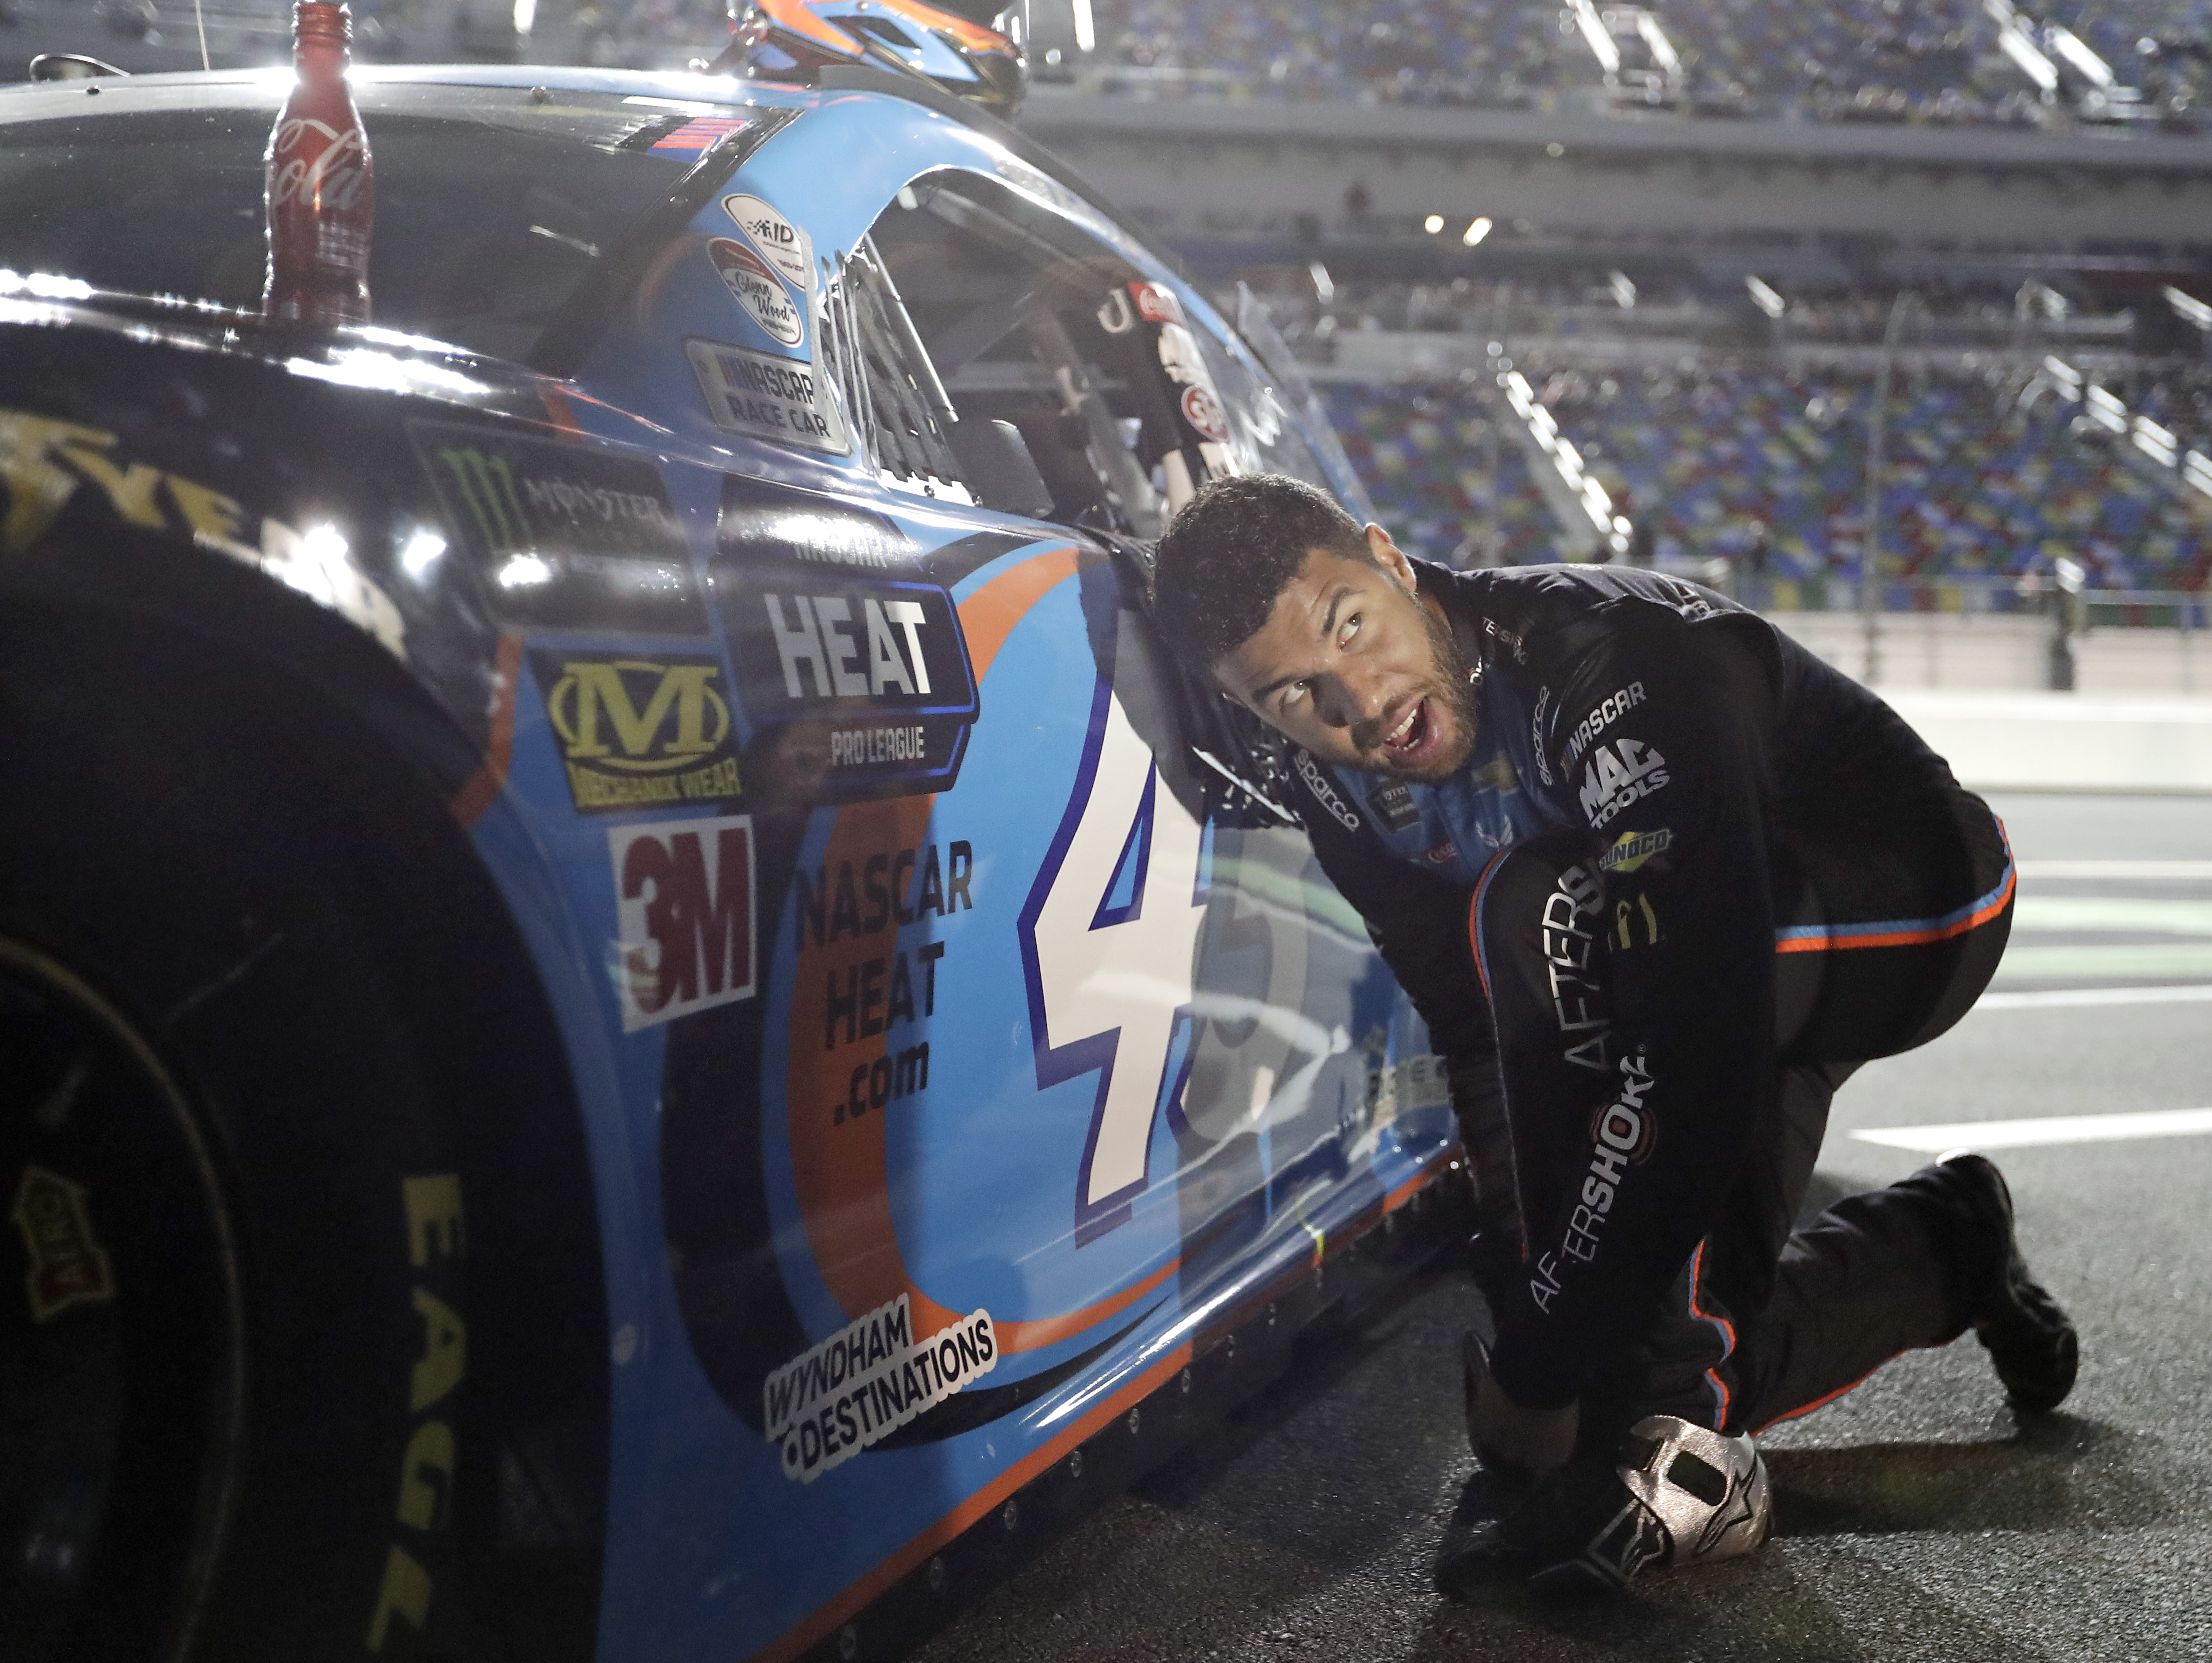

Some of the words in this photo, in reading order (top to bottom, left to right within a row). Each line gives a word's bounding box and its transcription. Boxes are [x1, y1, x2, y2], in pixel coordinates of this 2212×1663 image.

[753, 294, 790, 322] Wood
[725, 393, 788, 429] RACE
[788, 408, 832, 438] CAR
[738, 357, 814, 405] NASCAR
[523, 476, 669, 526] MONSTER
[765, 593, 931, 698] HEAT
[831, 731, 864, 767] PRO
[866, 726, 925, 763] LEAGUE
[1533, 685, 1555, 787] sparco
[1568, 681, 1647, 761] NASCAR
[1295, 749, 1360, 832] sparco
[1579, 738, 1666, 822] MAC
[1591, 769, 1670, 830] TOOLS
[1599, 829, 1669, 871] SUNOCO
[622, 827, 752, 1016] 3M
[793, 839, 974, 954] NASCAR
[825, 941, 945, 1051] HEAT
[833, 1041, 930, 1126] .com
[769, 1304, 910, 1427] WYNDHAM
[798, 1318, 993, 1471] DESTINATIONS
